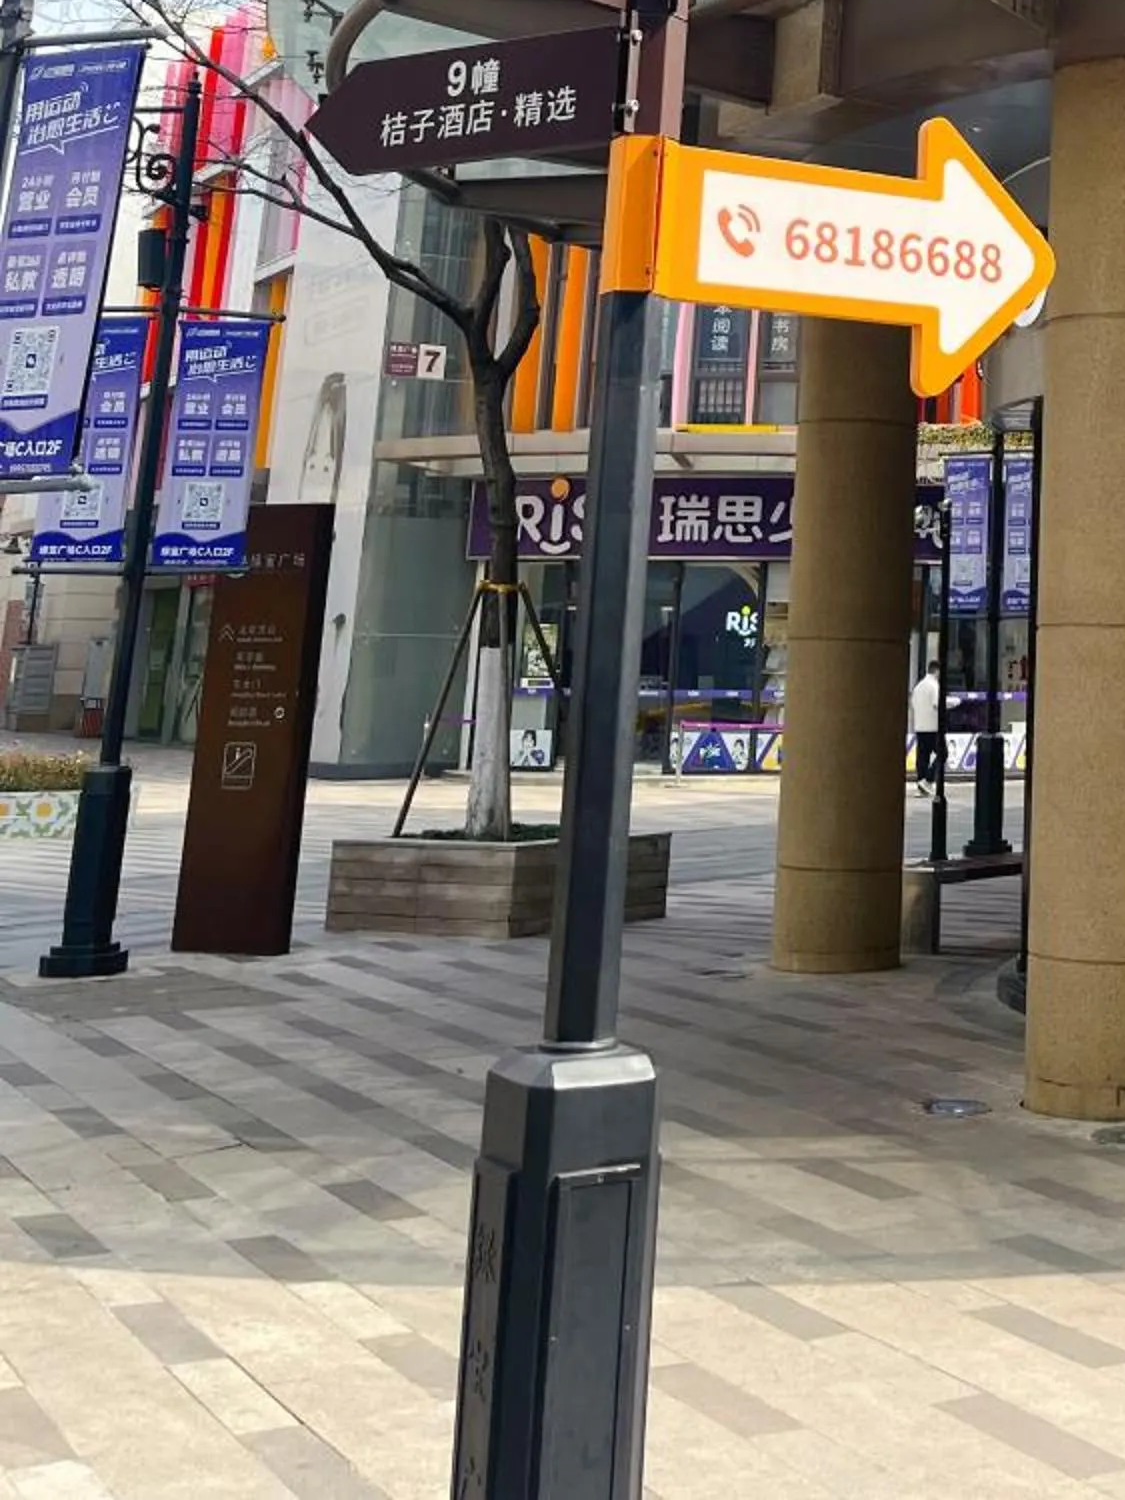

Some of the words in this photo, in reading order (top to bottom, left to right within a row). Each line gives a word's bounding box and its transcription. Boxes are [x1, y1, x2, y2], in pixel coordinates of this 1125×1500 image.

[447, 58, 500, 97] 9幢
[380, 86, 576, 147] 桔子酒店·精选
[18, 190, 50, 212] 营业
[66, 186, 99, 207] 会员
[784, 217, 1003, 283] 68186688
[424, 350, 440, 372] 7
